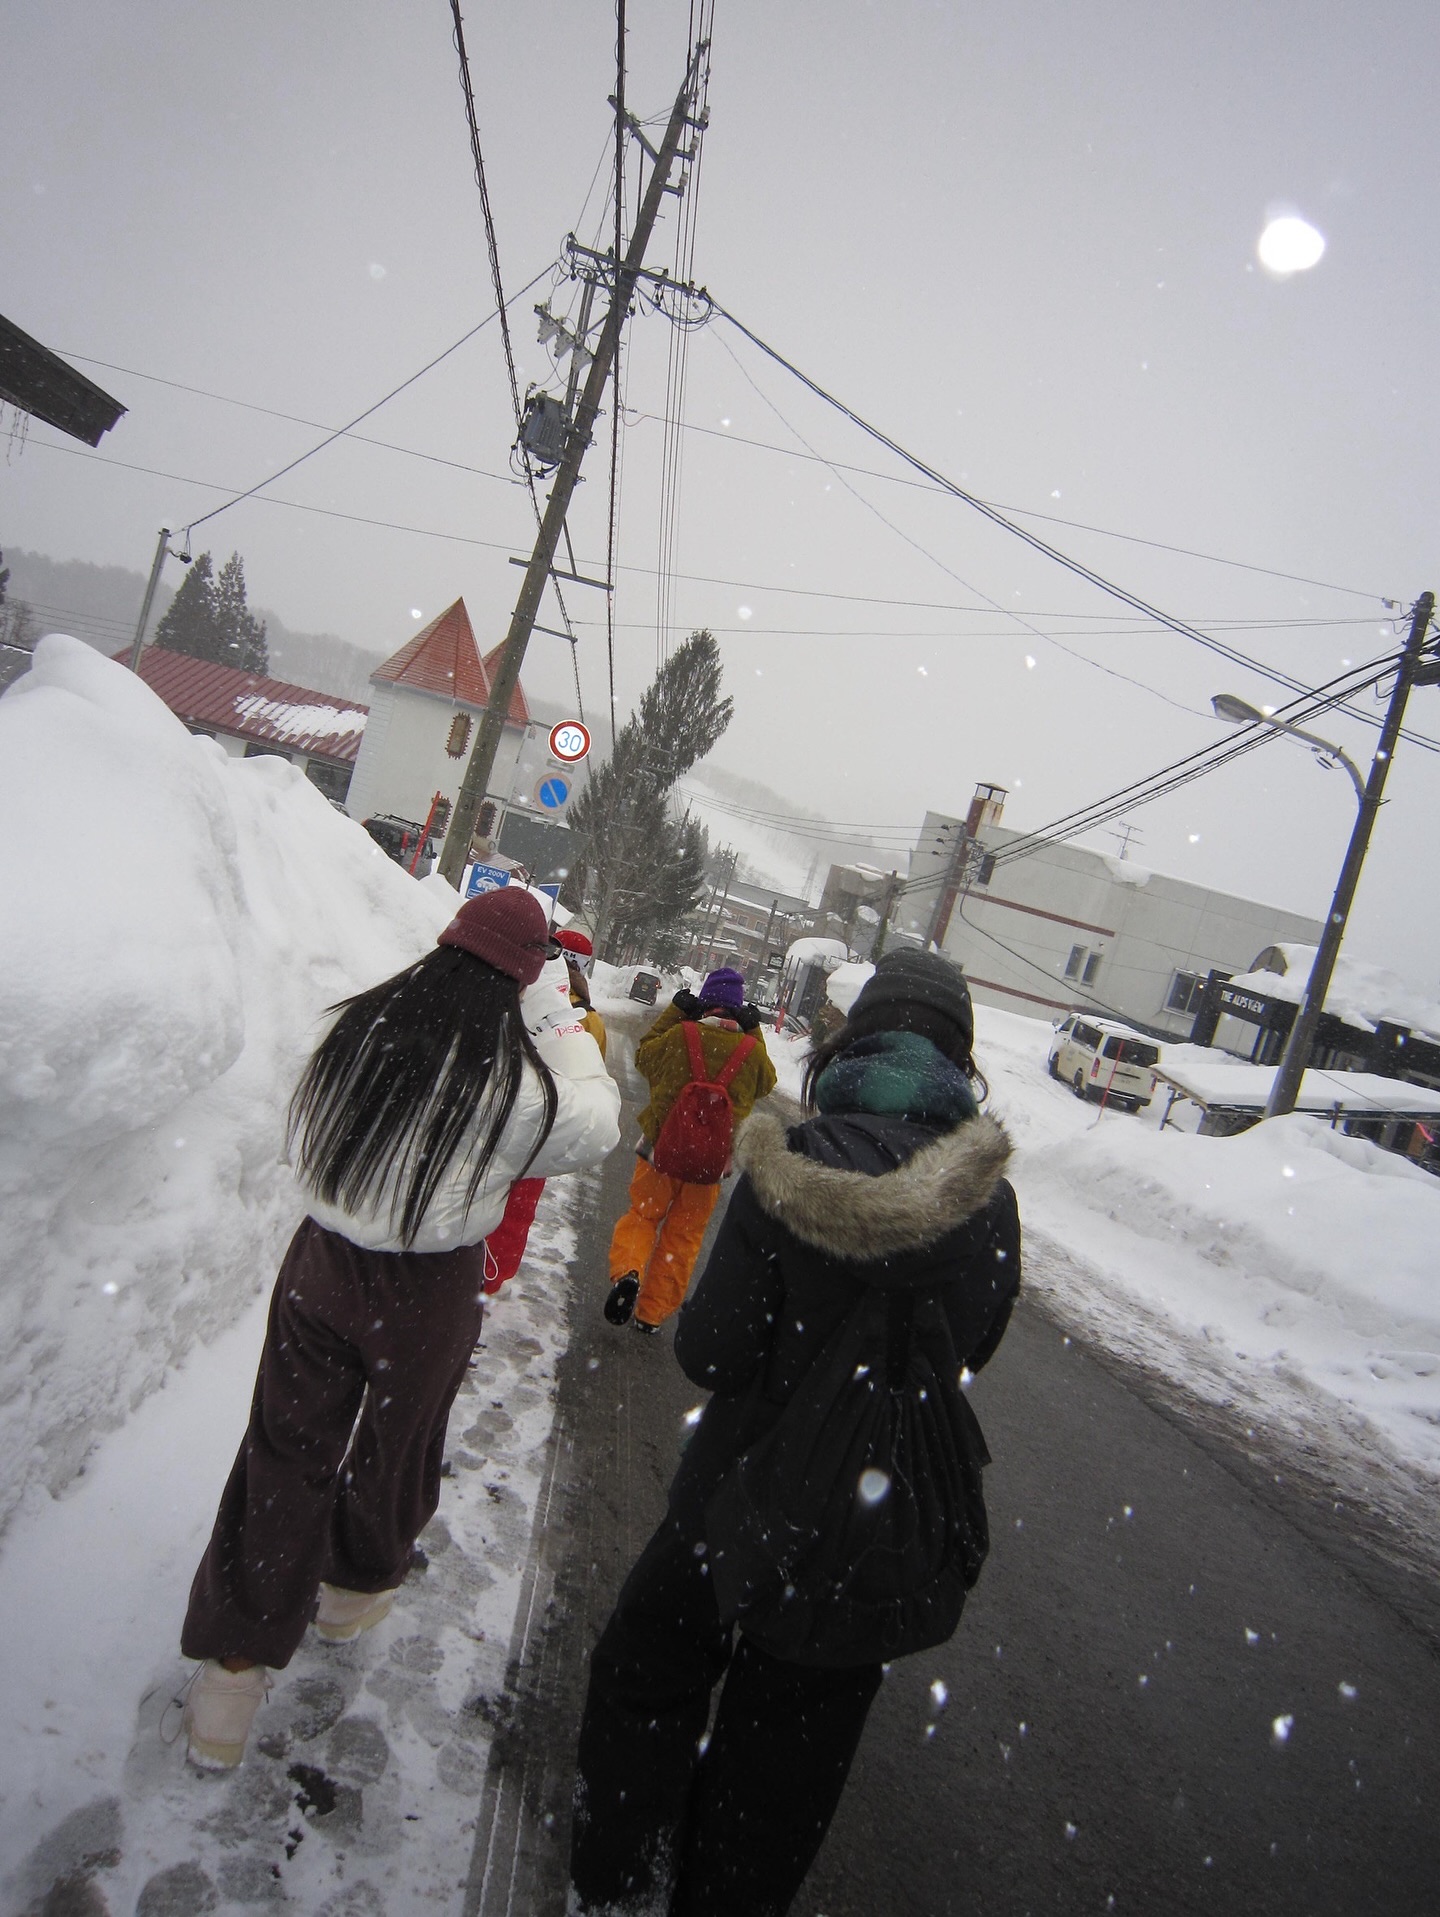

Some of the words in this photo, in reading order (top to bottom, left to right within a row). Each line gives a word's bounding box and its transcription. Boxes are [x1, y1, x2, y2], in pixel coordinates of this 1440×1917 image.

[558, 731, 582, 752] 30
[477, 866, 488, 874] EV
[488, 870, 506, 879] 200V
[1221, 990, 1234, 1003] THE
[1232, 994, 1248, 1009] ALPS
